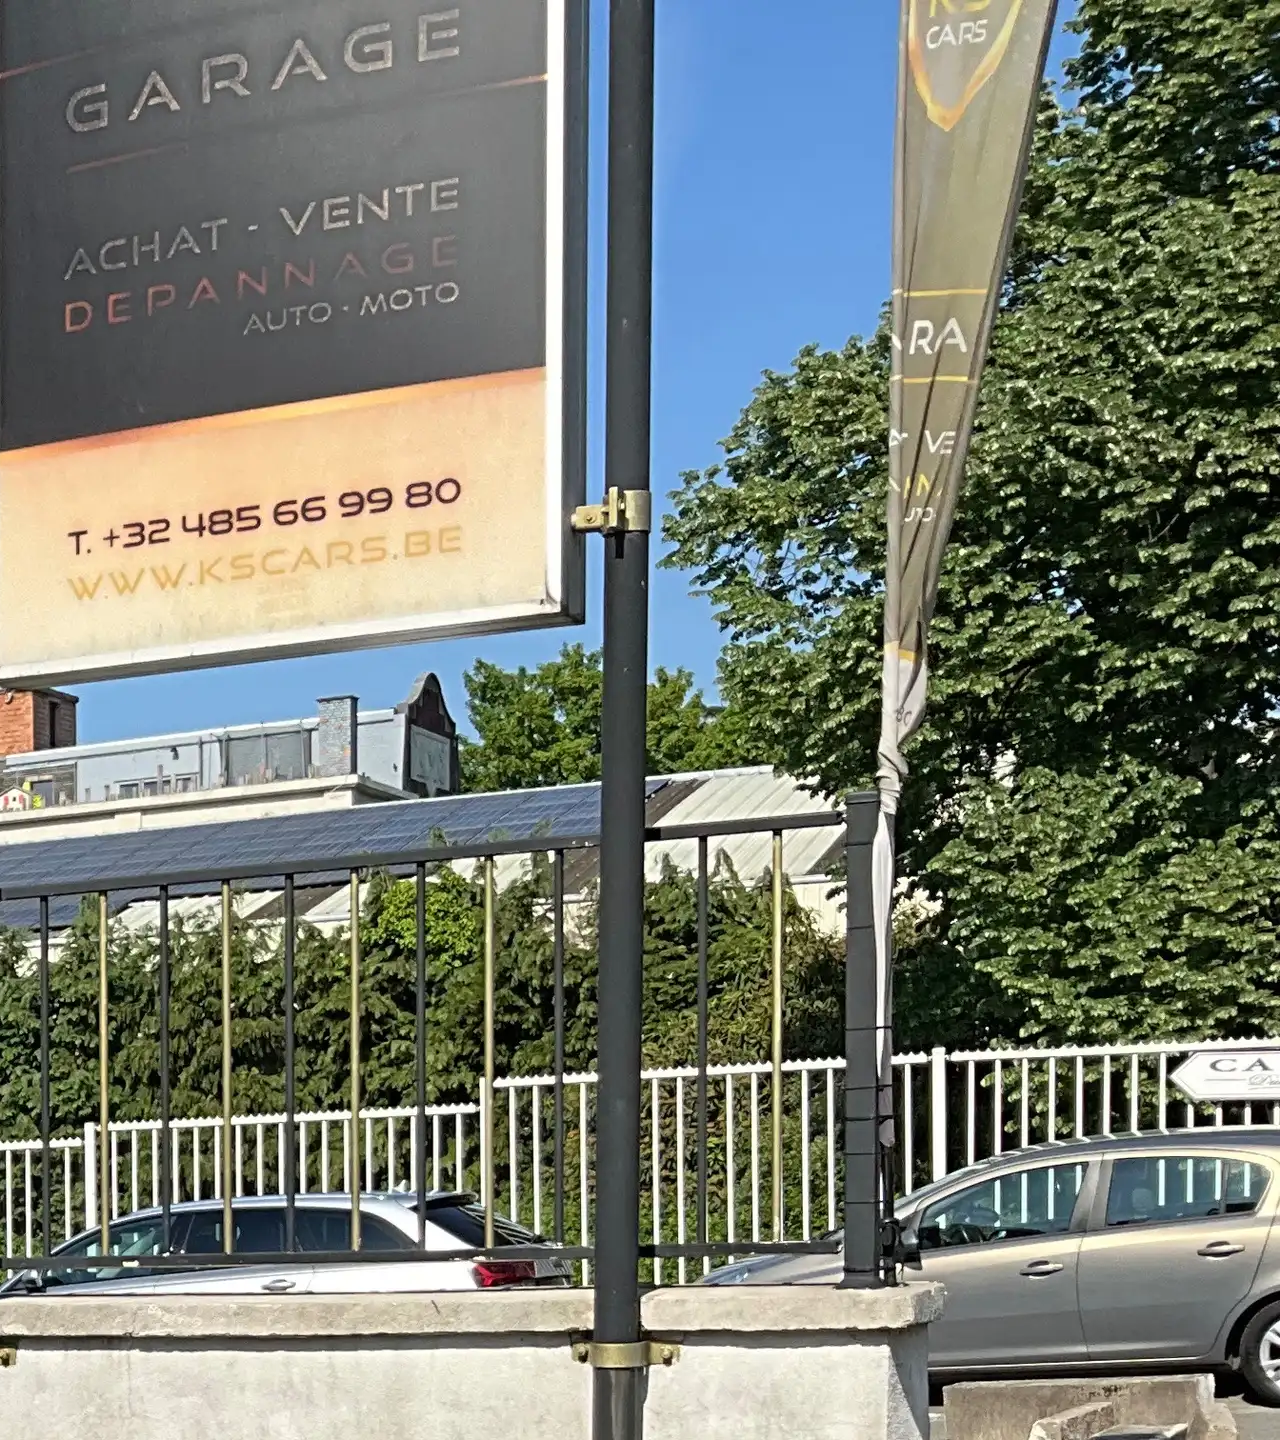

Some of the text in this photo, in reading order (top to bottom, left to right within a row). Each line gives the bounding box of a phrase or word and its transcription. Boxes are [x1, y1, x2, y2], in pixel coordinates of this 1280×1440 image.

[65, 8, 460, 133] GARAGE
[926, 19, 988, 49] CARS
[63, 218, 228, 281] ACHAT
[279, 177, 460, 236] VENTE
[64, 235, 457, 333] DEPANNAGE
[243, 281, 460, 336] AUTO MOTO
[67, 477, 462, 556] T. +32 485 66 99 80
[66, 526, 463, 602] WWW.KSCARS.BE
